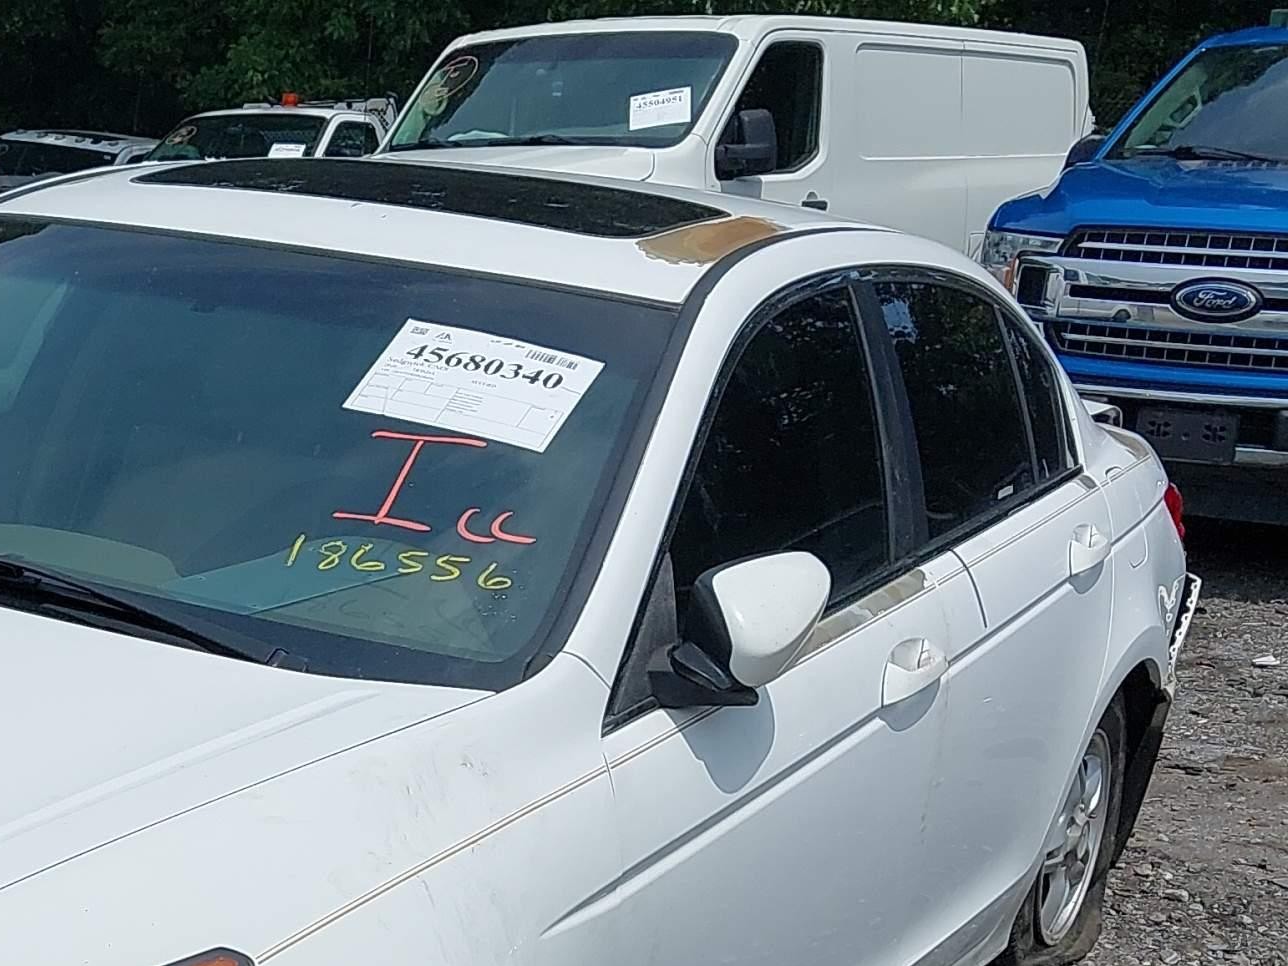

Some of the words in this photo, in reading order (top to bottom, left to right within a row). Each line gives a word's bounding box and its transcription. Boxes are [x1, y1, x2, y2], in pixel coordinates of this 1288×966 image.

[635, 95, 682, 109] 45504951
[1193, 289, 1237, 308] Ford
[405, 344, 564, 389] 45680340
[285, 533, 513, 590] 186556
